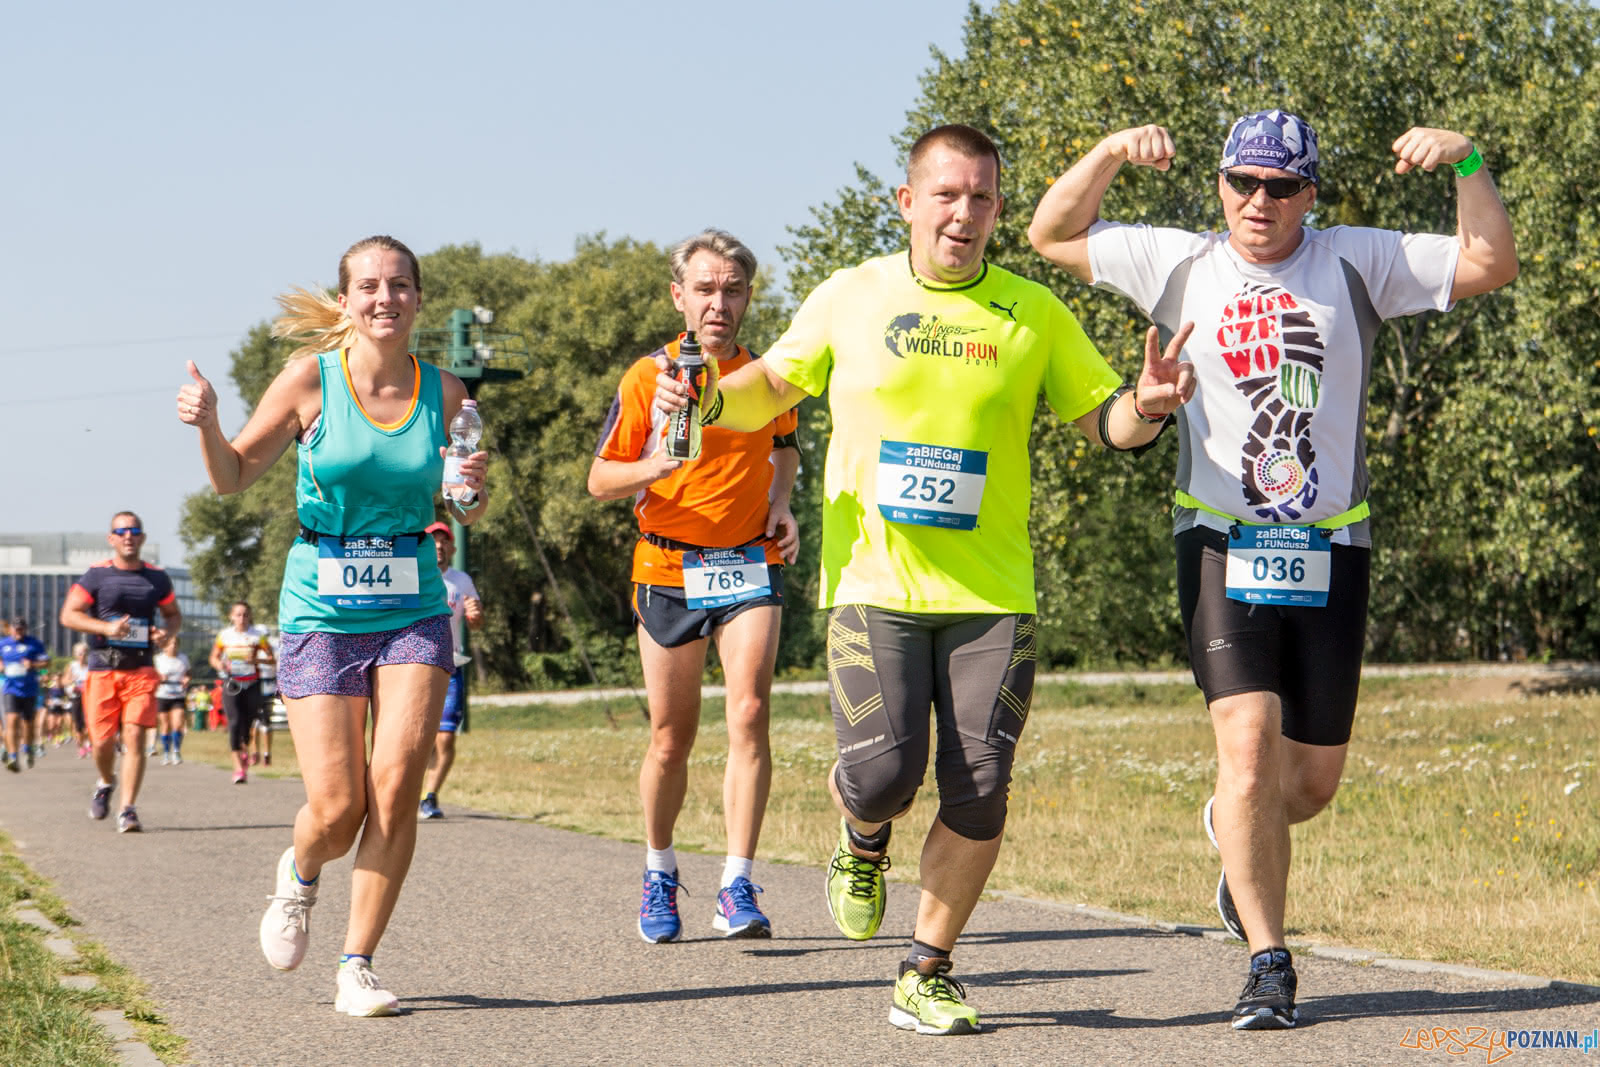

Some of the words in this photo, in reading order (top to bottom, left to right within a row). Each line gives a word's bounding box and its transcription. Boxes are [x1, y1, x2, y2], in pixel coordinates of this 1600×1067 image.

[1216, 315, 1279, 347] CZE
[905, 337, 963, 358] WORLD
[966, 342, 997, 361] RUN
[1220, 344, 1280, 378] WO
[1281, 363, 1321, 408] RUN
[906, 446, 963, 464] zaBIEGaj
[914, 458, 961, 471] FUNdusze
[899, 474, 956, 505] 252
[344, 538, 393, 551] zaBEGaj
[1256, 528, 1310, 542] zaBIEGaj
[1264, 540, 1309, 549] FUNdusze
[352, 549, 393, 558] FUNdusze
[343, 565, 392, 588] 044
[704, 570, 745, 591] 768
[1253, 556, 1305, 583] 036
